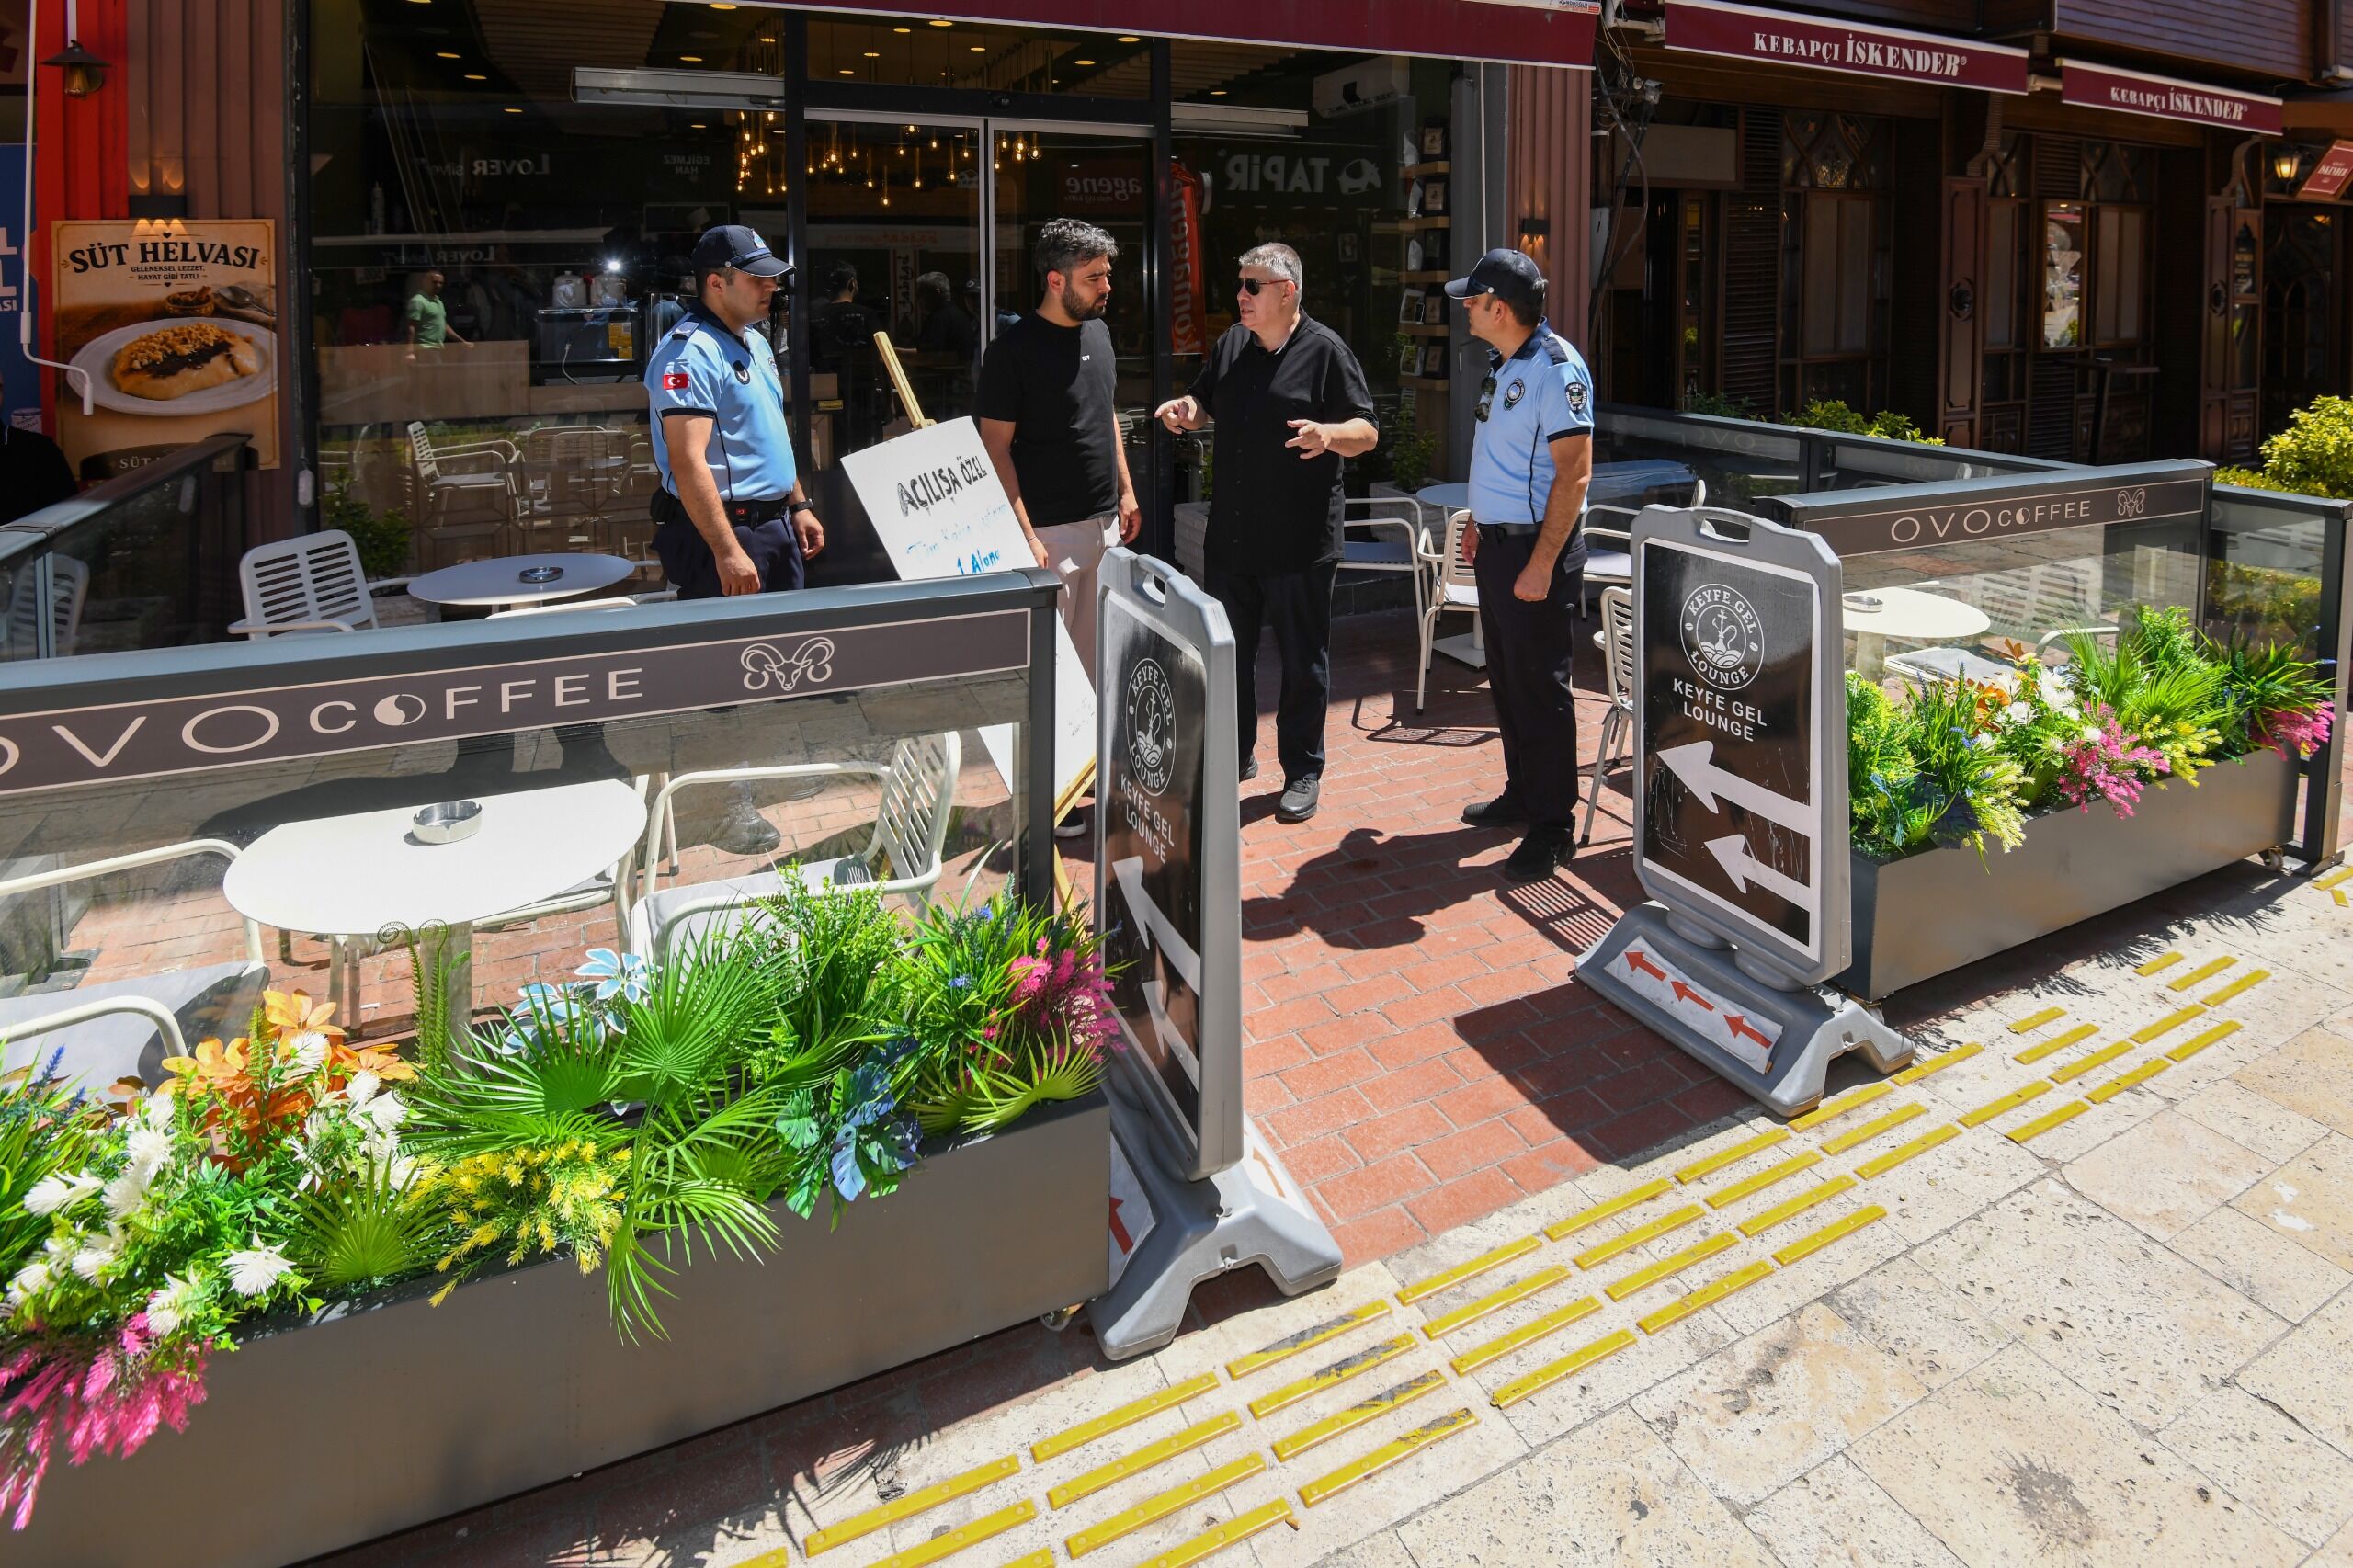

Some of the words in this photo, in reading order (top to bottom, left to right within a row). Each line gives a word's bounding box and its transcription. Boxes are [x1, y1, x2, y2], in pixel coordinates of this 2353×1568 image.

[1753, 32, 1840, 63] KEBAPÇI
[2110, 86, 2166, 112] KEBAPÇI
[69, 242, 129, 273] SÜT
[139, 242, 260, 270] HELVASI
[131, 265, 177, 273] GELENEKSEL
[179, 273, 199, 281] TATLI
[119, 456, 152, 469] SÜT
[897, 467, 963, 517] AÇILIŞA
[956, 456, 988, 486] ÖZEL
[1891, 509, 1991, 542] OVO
[1997, 500, 2091, 527] COFFEE
[1688, 589, 1731, 616] KEYFE
[1733, 600, 1757, 634] GEL
[1690, 650, 1749, 685] LOUNGE
[1131, 665, 1159, 697] KEYFE
[1160, 682, 1173, 726] GEL
[1672, 677, 1725, 710] KEYFE
[1732, 700, 1768, 727] GEL
[0, 705, 280, 774] VO
[309, 668, 643, 734] COFFEE
[1683, 701, 1754, 743] LOUNGE
[1131, 740, 1165, 789] LOUNGE
[1120, 773, 1151, 821] KEYFE
[1154, 811, 1175, 847] GEL
[1126, 804, 1166, 866] LOUNGE
